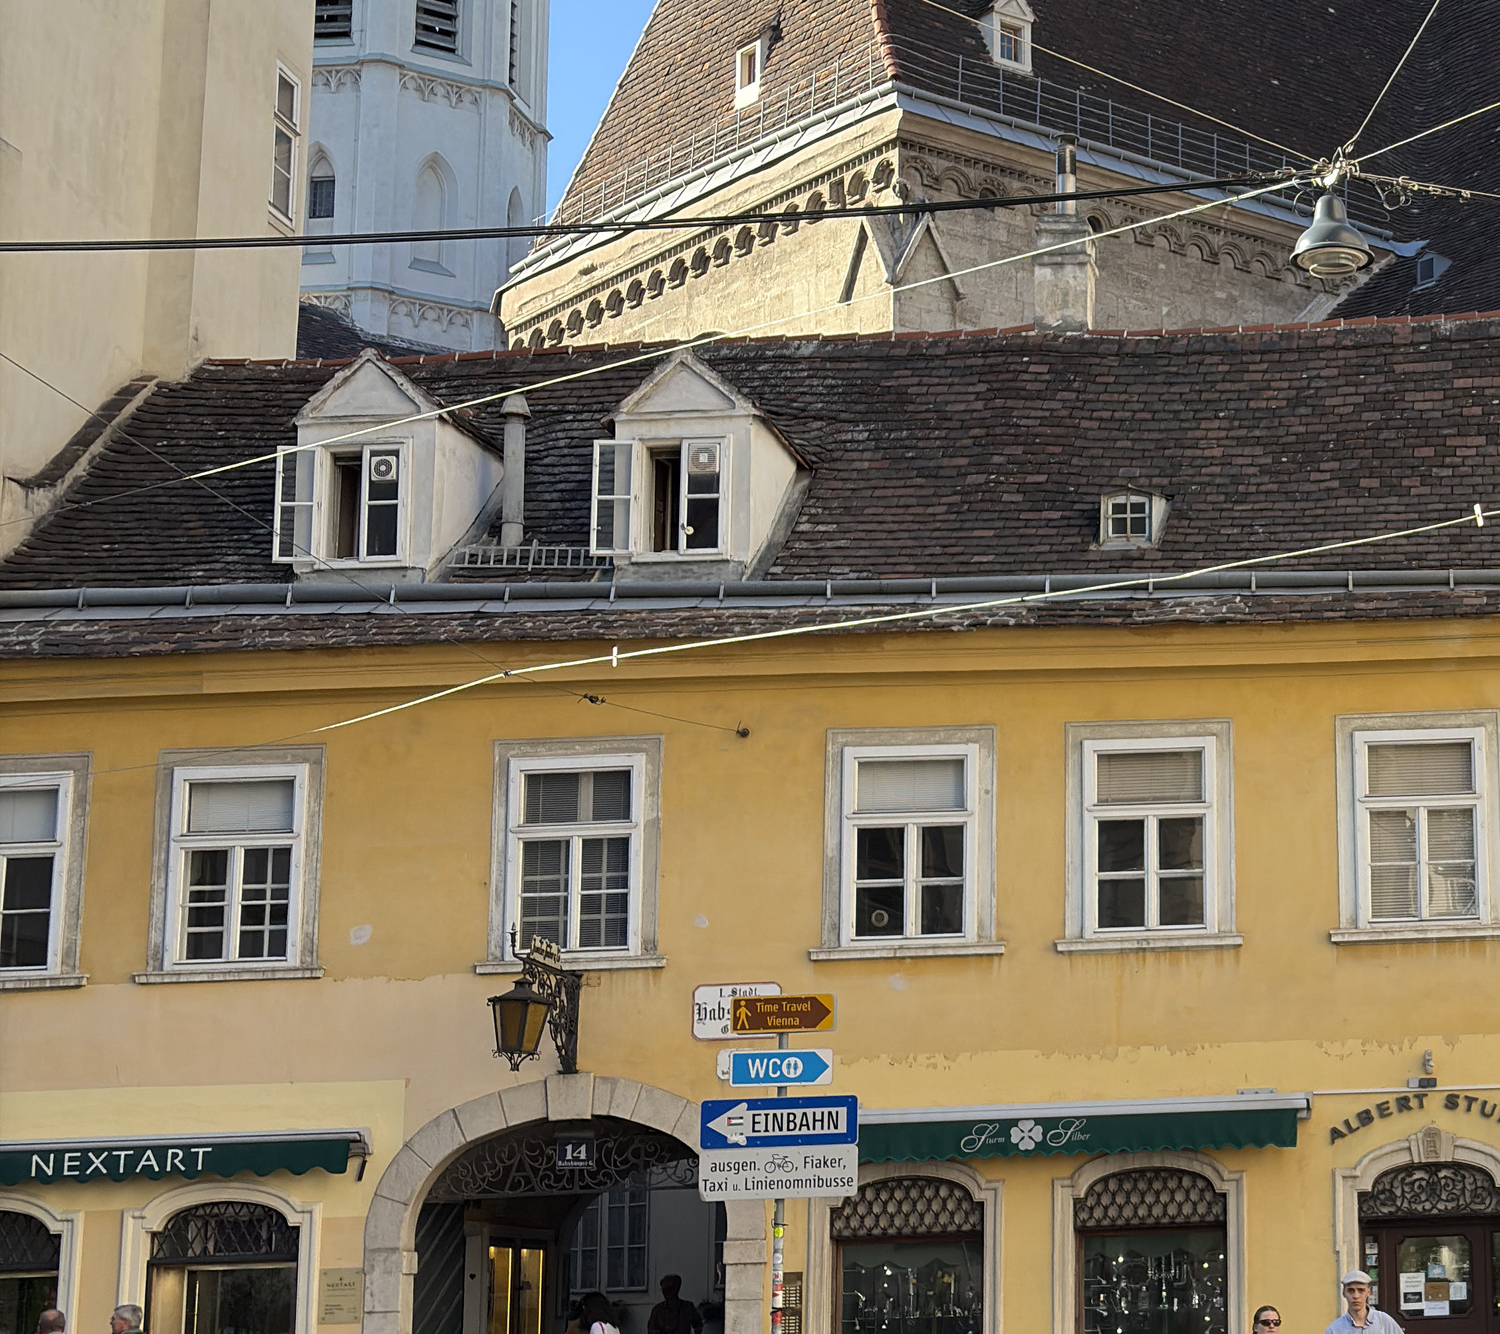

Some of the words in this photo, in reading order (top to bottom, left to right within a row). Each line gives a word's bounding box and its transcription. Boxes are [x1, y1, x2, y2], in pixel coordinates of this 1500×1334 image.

[756, 1002, 779, 1013] Time
[781, 1000, 811, 1012] Travel
[767, 1016, 800, 1027] Vienna
[748, 1058, 781, 1079] WC
[751, 1110, 839, 1134] EINBAHN
[1328, 1093, 1429, 1145] ALBERT
[960, 1123, 1005, 1153] Sturm
[1047, 1118, 1091, 1146] Silber
[565, 1143, 587, 1160] 14
[30, 1147, 213, 1177] NEXTART
[710, 1159, 760, 1175] ausgen.
[803, 1155, 846, 1170] Fiaker,
[702, 1177, 728, 1192] Taxi
[732, 1182, 741, 1192] u.
[744, 1174, 854, 1191] Linienomnibusse
